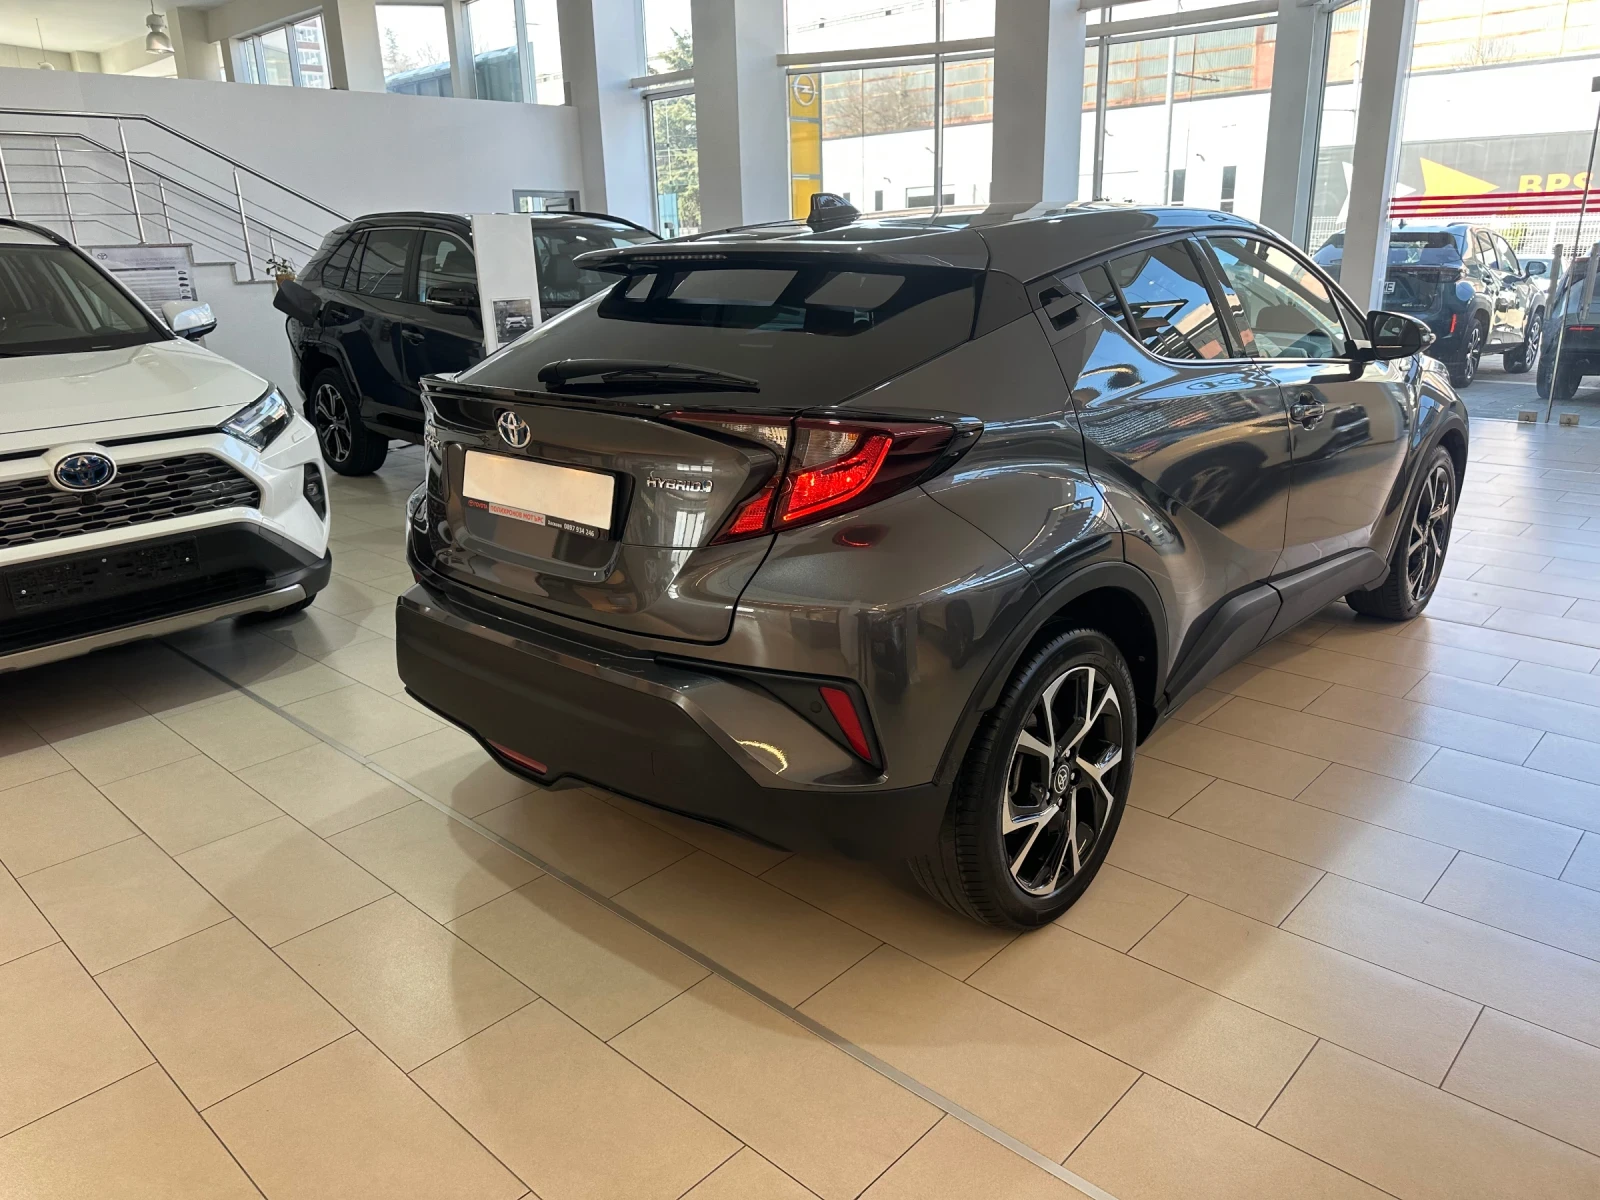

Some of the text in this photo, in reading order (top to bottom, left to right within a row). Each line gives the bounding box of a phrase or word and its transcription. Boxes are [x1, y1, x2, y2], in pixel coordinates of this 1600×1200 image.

[646, 477, 701, 492] HYBRID
[563, 523, 576, 531] 0897
[576, 526, 585, 534] 934
[585, 529, 594, 537] 246
